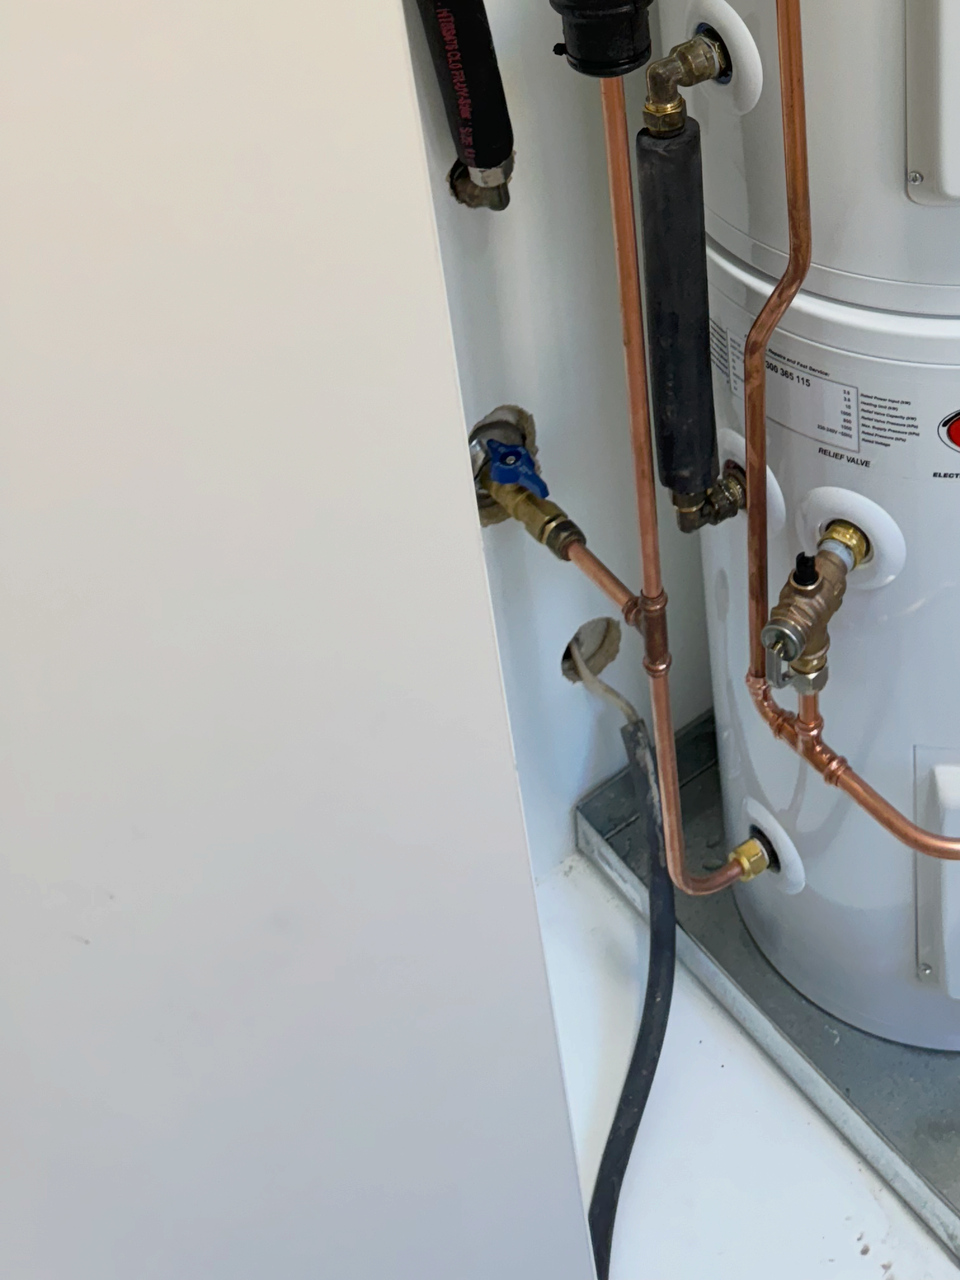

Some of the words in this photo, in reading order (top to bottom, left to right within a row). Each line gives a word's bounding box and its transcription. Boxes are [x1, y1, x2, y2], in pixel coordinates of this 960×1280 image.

[780, 369, 794, 381] 365
[796, 375, 811, 387] 115
[819, 448, 844, 460] RELIEF
[846, 455, 871, 467] VALVE
